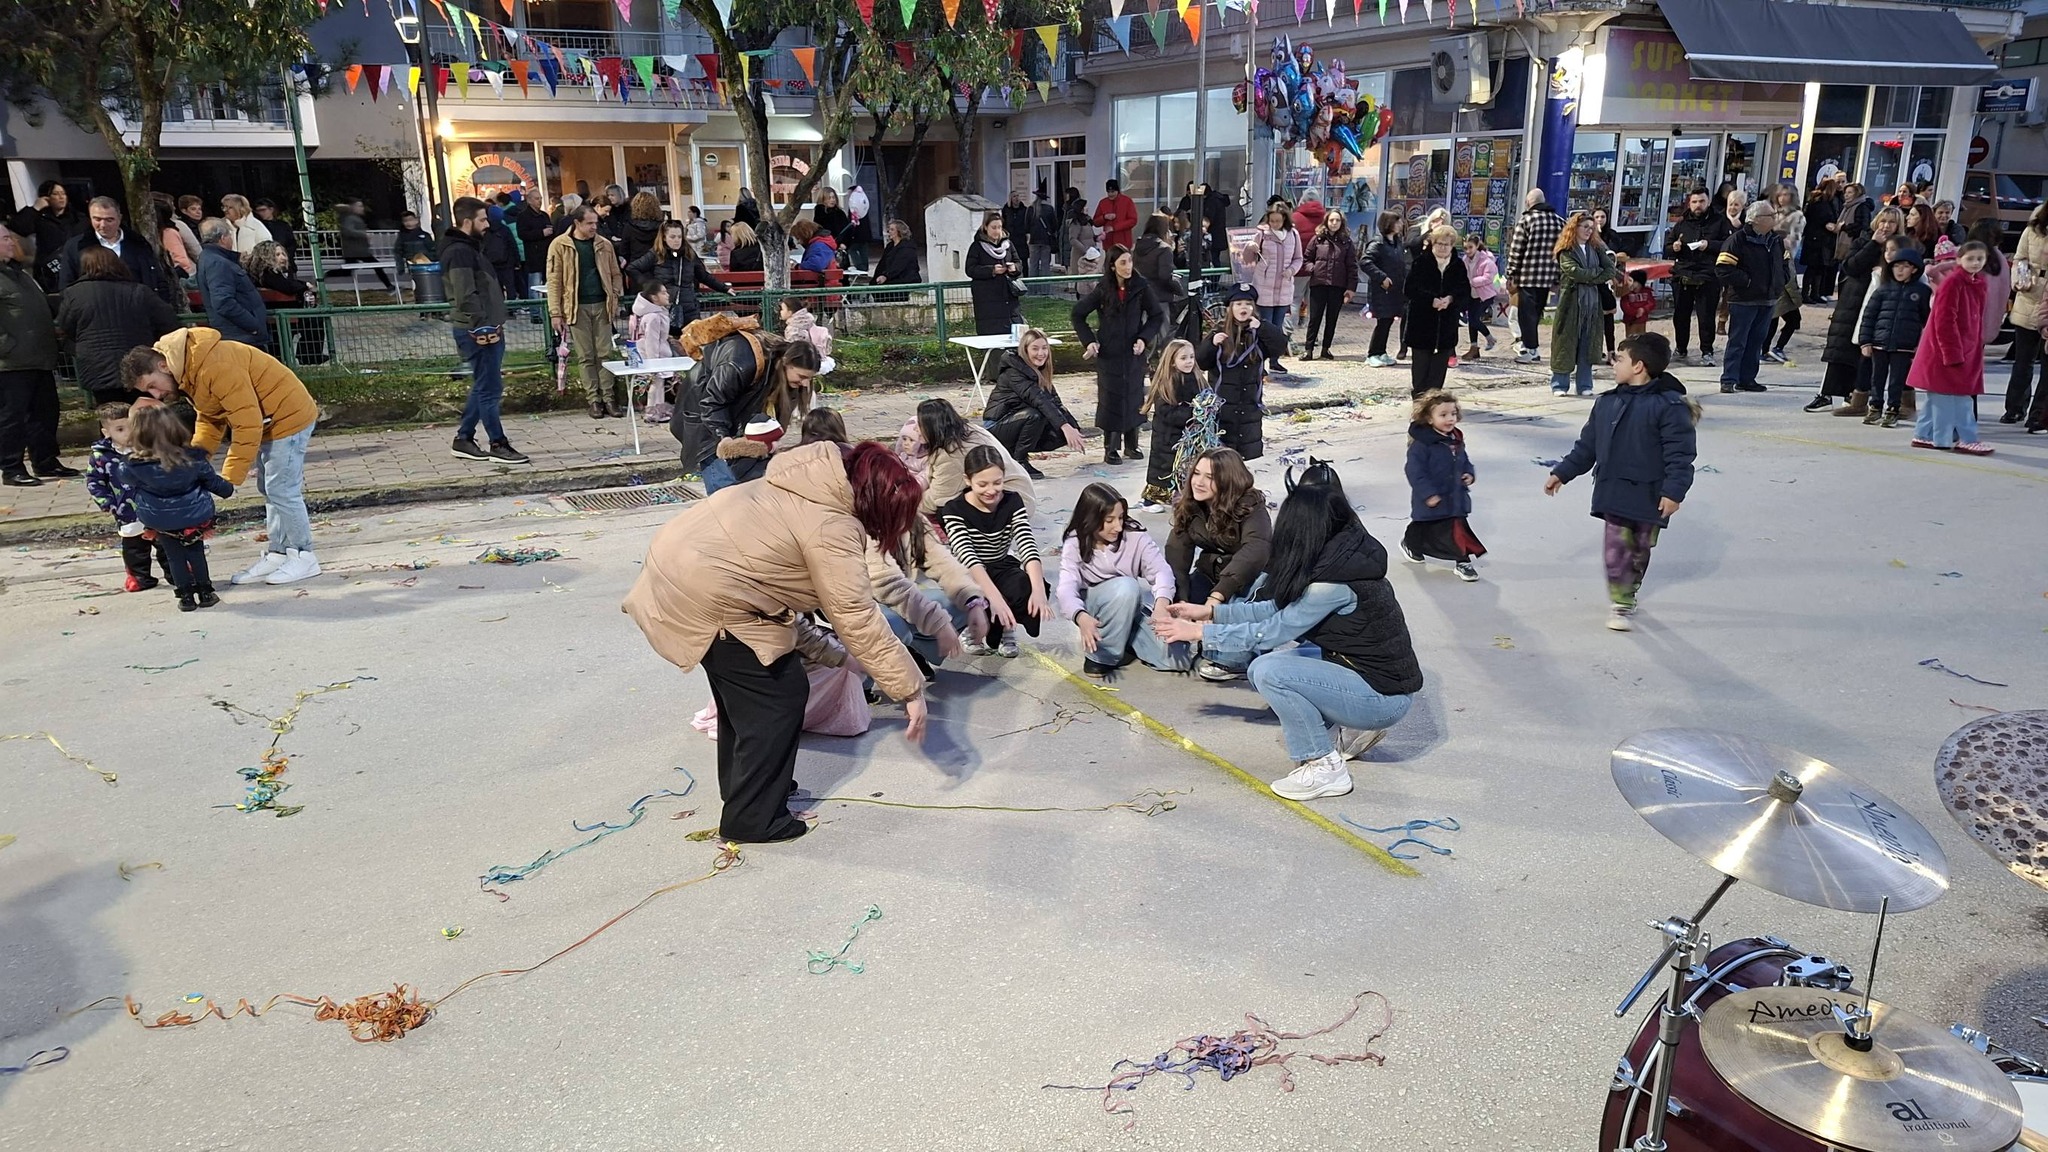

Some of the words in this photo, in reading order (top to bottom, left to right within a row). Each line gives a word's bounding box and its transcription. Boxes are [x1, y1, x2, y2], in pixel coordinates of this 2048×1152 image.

[1631, 41, 1684, 72] SUP
[1886, 1098, 1933, 1122] al
[1903, 1118, 1971, 1133] traditional
